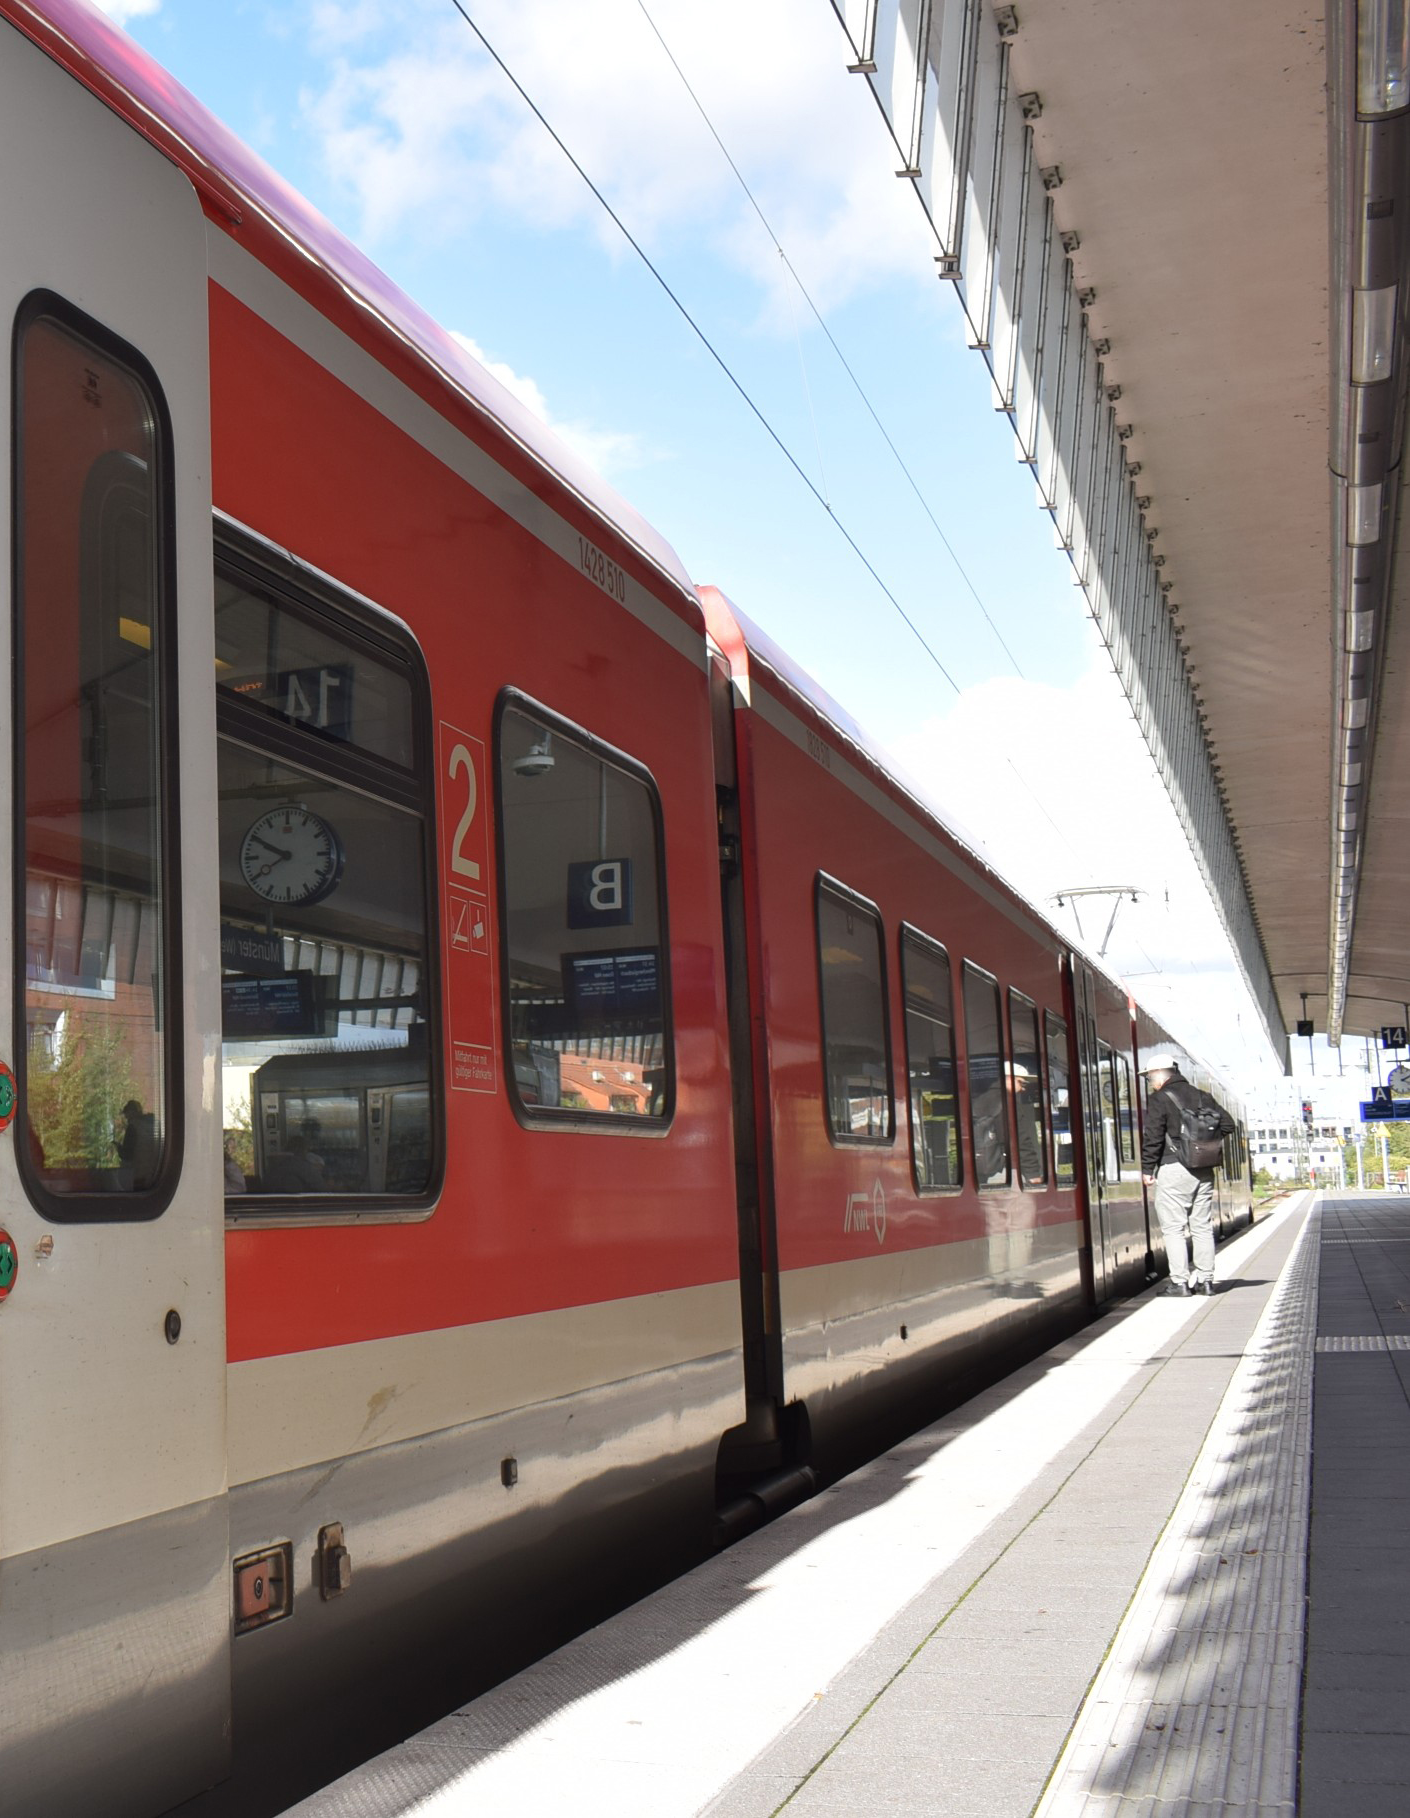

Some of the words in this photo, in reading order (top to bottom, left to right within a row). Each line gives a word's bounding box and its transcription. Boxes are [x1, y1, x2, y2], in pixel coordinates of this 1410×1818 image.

[579, 537, 605, 586] 1428
[607, 560, 625, 602] 510
[449, 744, 480, 880] 2
[1383, 1028, 1404, 1045] 14
[1375, 1087, 1387, 1101] A
[853, 1209, 870, 1232] NWL
